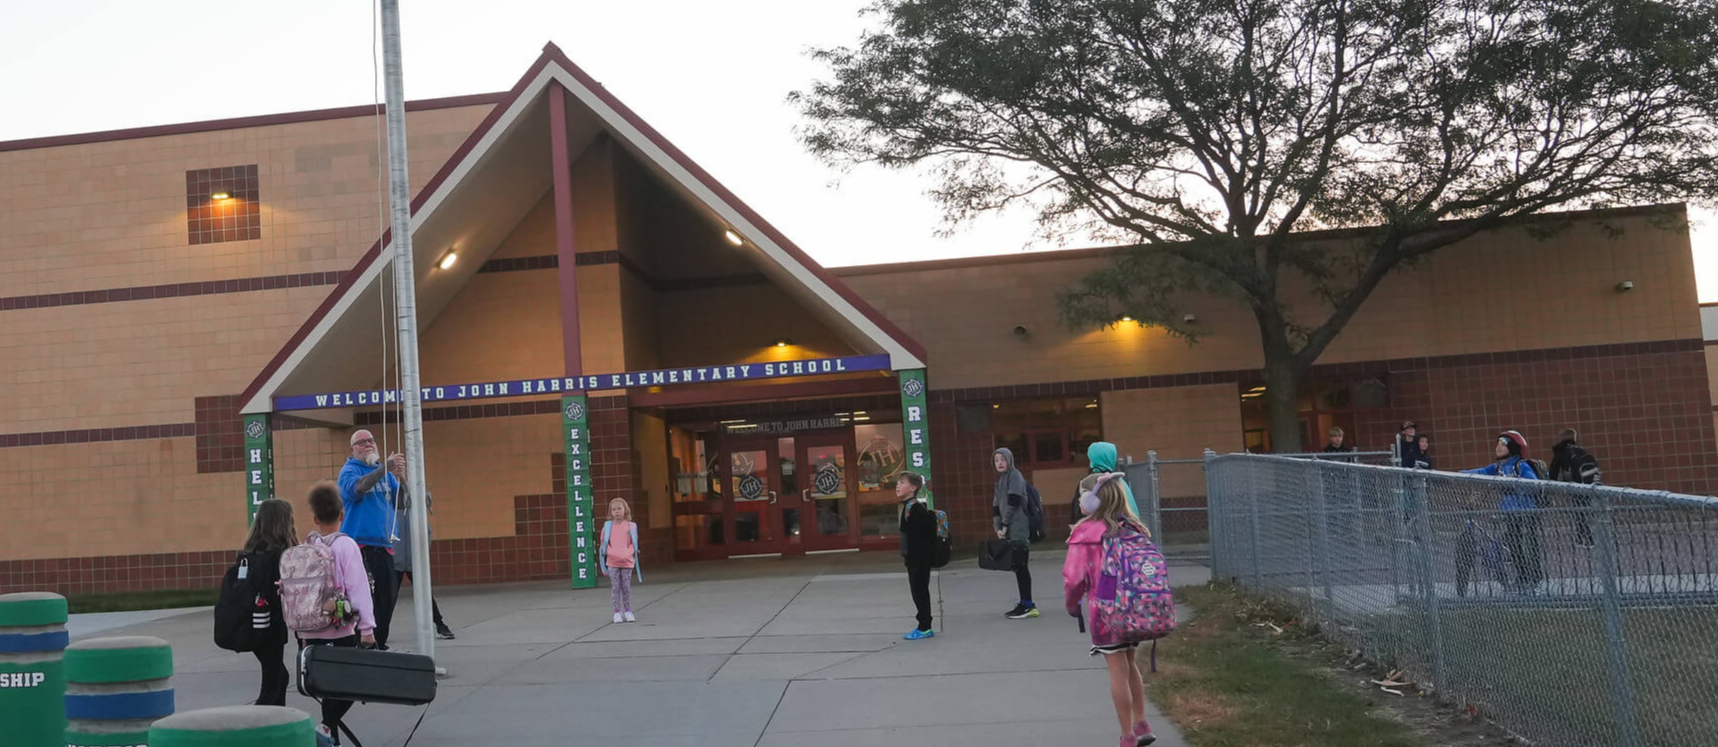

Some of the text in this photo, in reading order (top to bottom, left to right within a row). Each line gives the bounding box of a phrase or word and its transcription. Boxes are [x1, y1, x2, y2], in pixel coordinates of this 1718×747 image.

[315, 358, 845, 406] WELCOM TO JOHN HARRIS ELEMENTARY SCHOOL
[250, 449, 263, 520] HEL
[907, 406, 926, 502] RES
[571, 428, 587, 579] EXCELLENCE
[0, 672, 45, 688] SHIP
